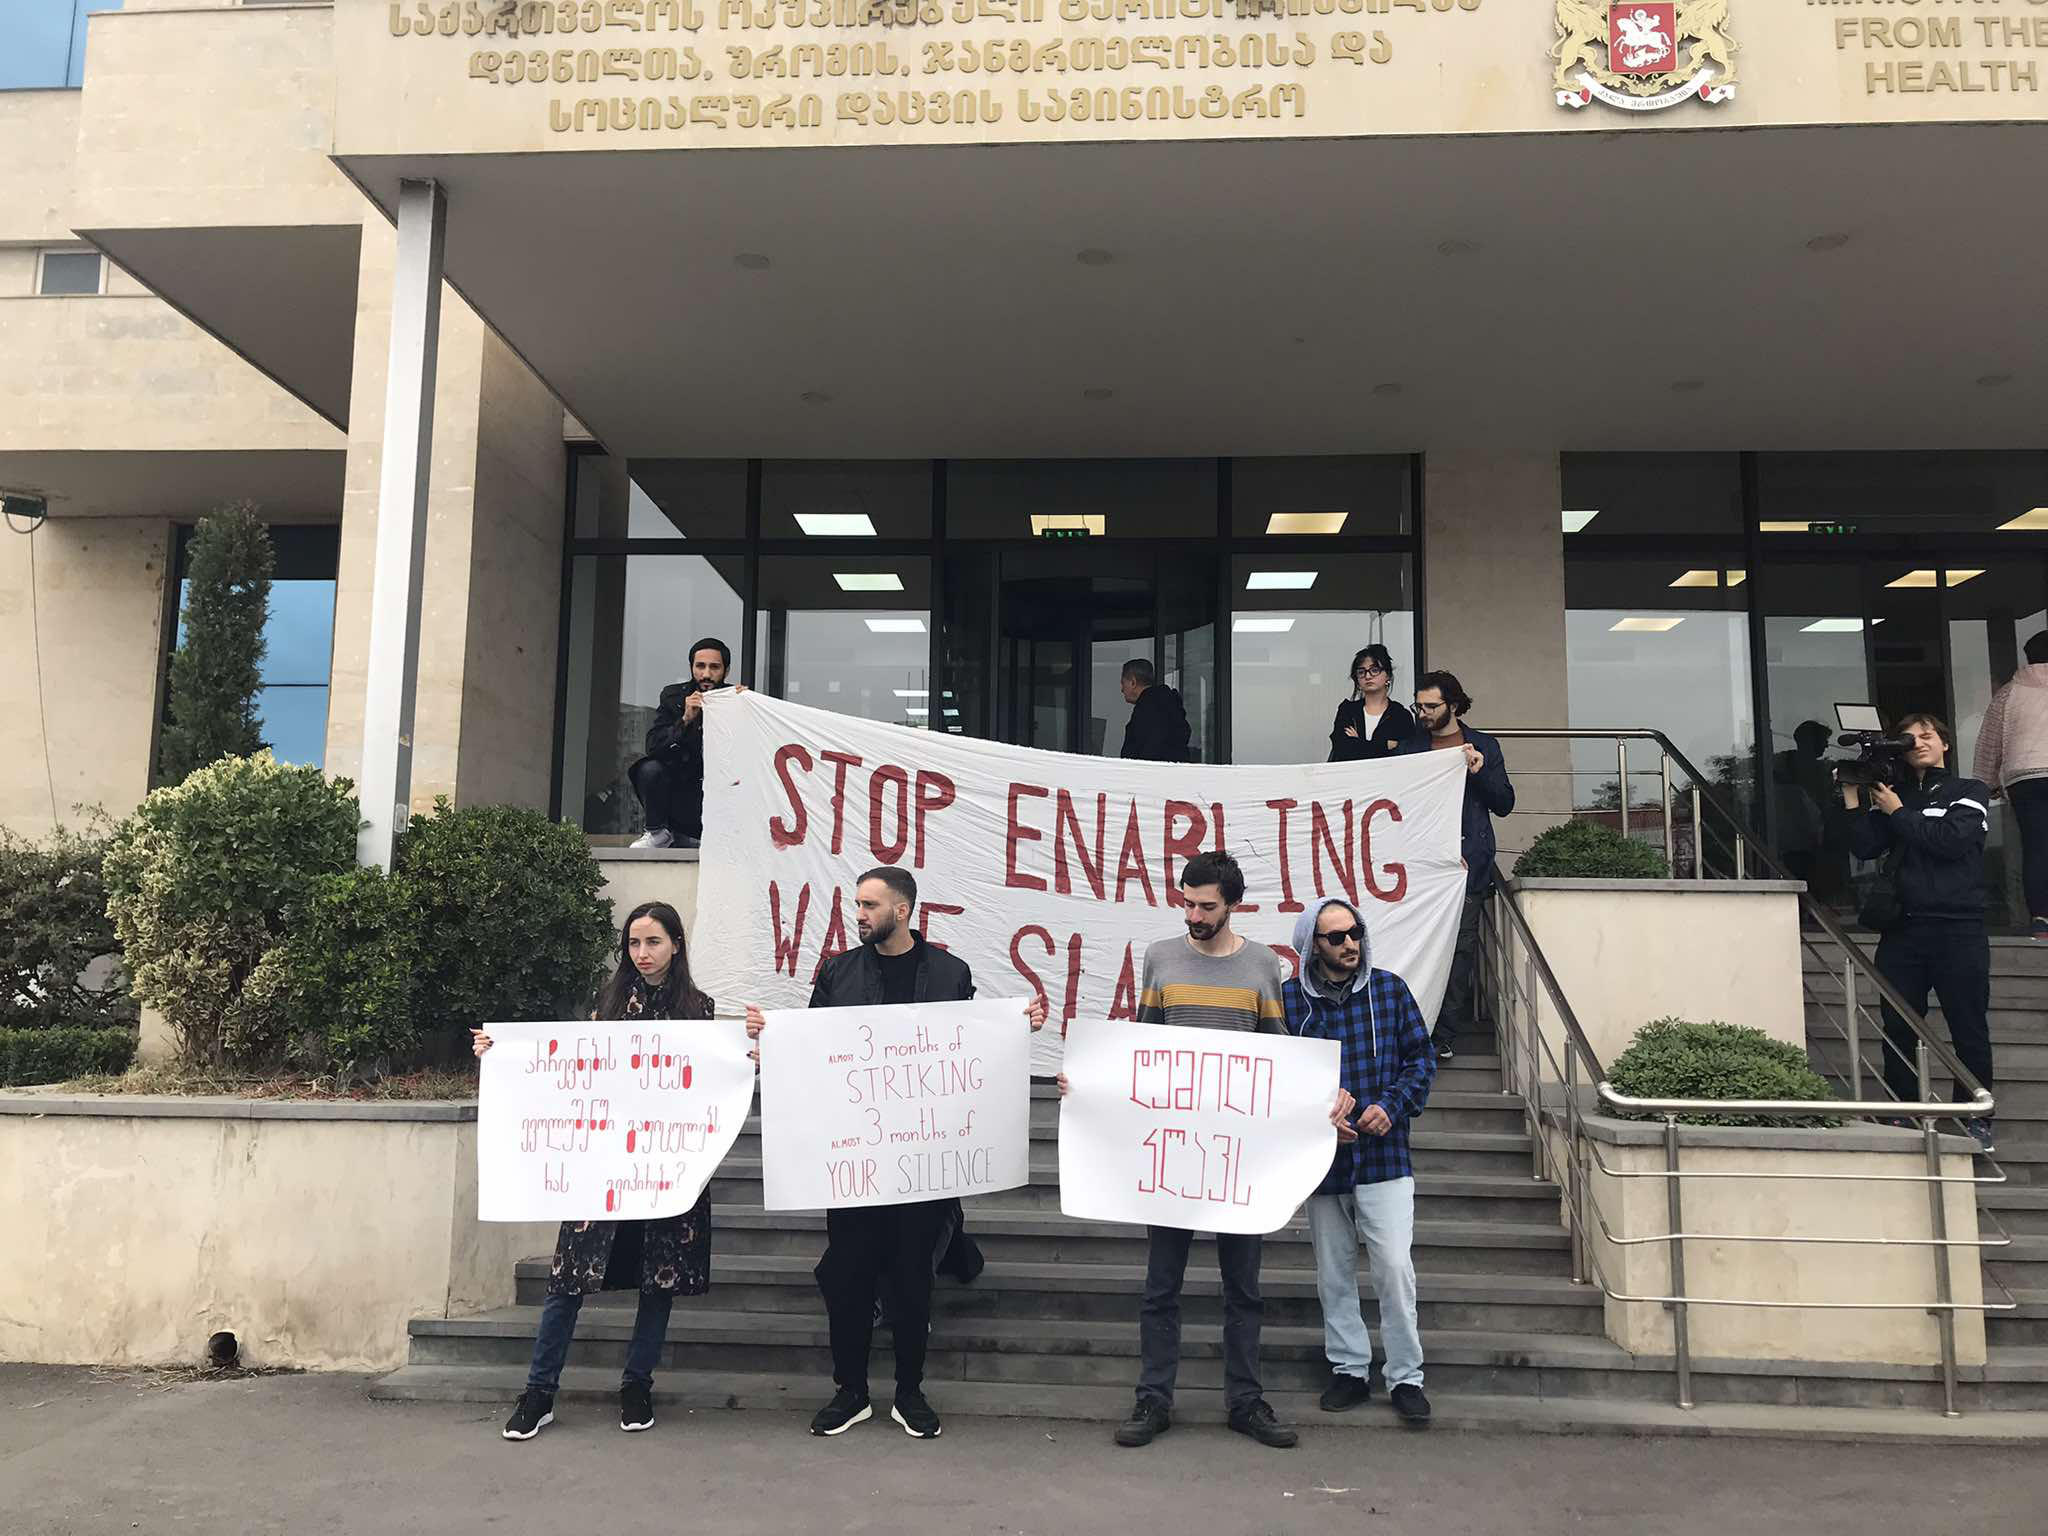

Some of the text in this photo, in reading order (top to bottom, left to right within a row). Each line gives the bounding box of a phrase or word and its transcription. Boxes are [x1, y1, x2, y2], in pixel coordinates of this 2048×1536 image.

[388, 0, 704, 37] საქართველოს
[1834, 16, 2048, 49] FROM THE
[468, 30, 1393, 84] დევნილთა, შრომის, ჯანმრთელობისა და
[1865, 60, 2038, 94] HEALTH
[550, 83, 1306, 132] სოციალური დაცვის სამინისტრო
[770, 743, 1408, 914] STOP ENABLING
[769, 879, 966, 985] WAE
[828, 1024, 965, 1064] ALMOST 3 months of
[846, 1056, 984, 1104] STRIKING
[1129, 1049, 1273, 1118] დუმილი
[831, 1106, 976, 1149] ALMOST 3 months of
[544, 1161, 570, 1193] რას
[826, 1146, 996, 1200] YOUR SILENCE
[1138, 1128, 1251, 1206] კლავს
